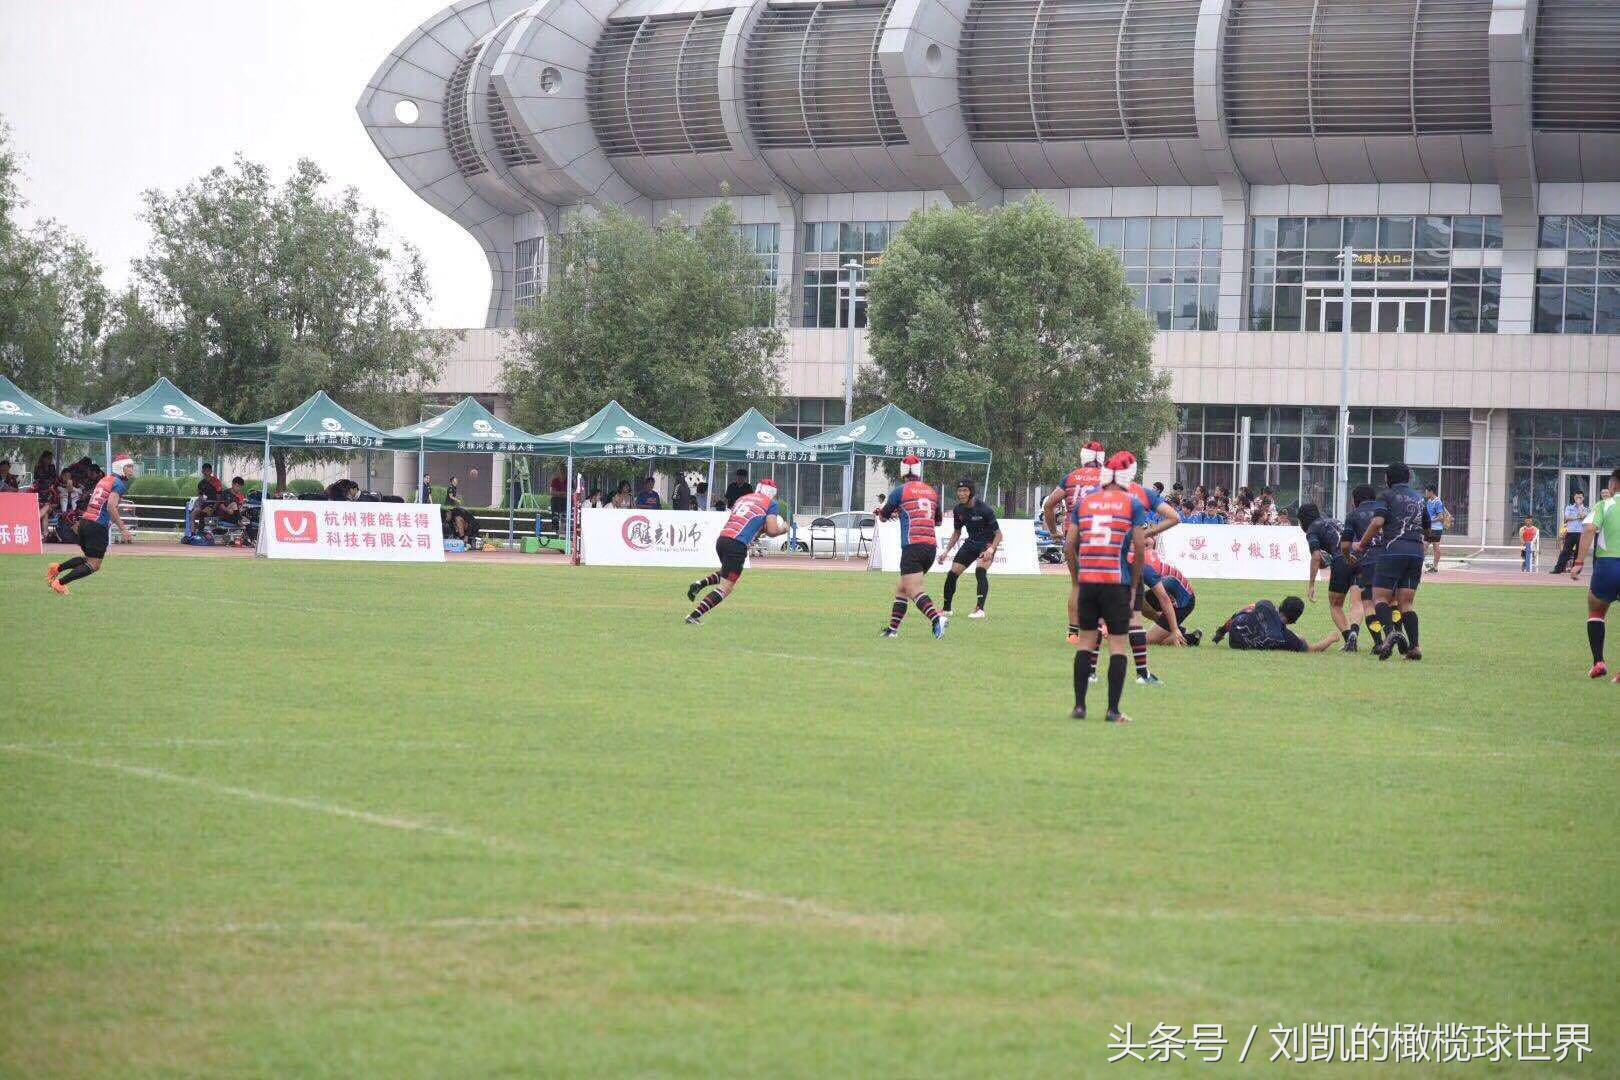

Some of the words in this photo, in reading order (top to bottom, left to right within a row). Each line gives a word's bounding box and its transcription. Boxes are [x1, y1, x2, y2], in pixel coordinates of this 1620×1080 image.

[604, 444, 678, 456] 相信品格的力量
[745, 447, 817, 461] 相信品格的力量
[884, 444, 956, 460] 相信品格的力量
[323, 510, 430, 529] 杭州雅皓佳得
[1089, 514, 1113, 545] 5
[326, 531, 432, 550] 科技有限公司
